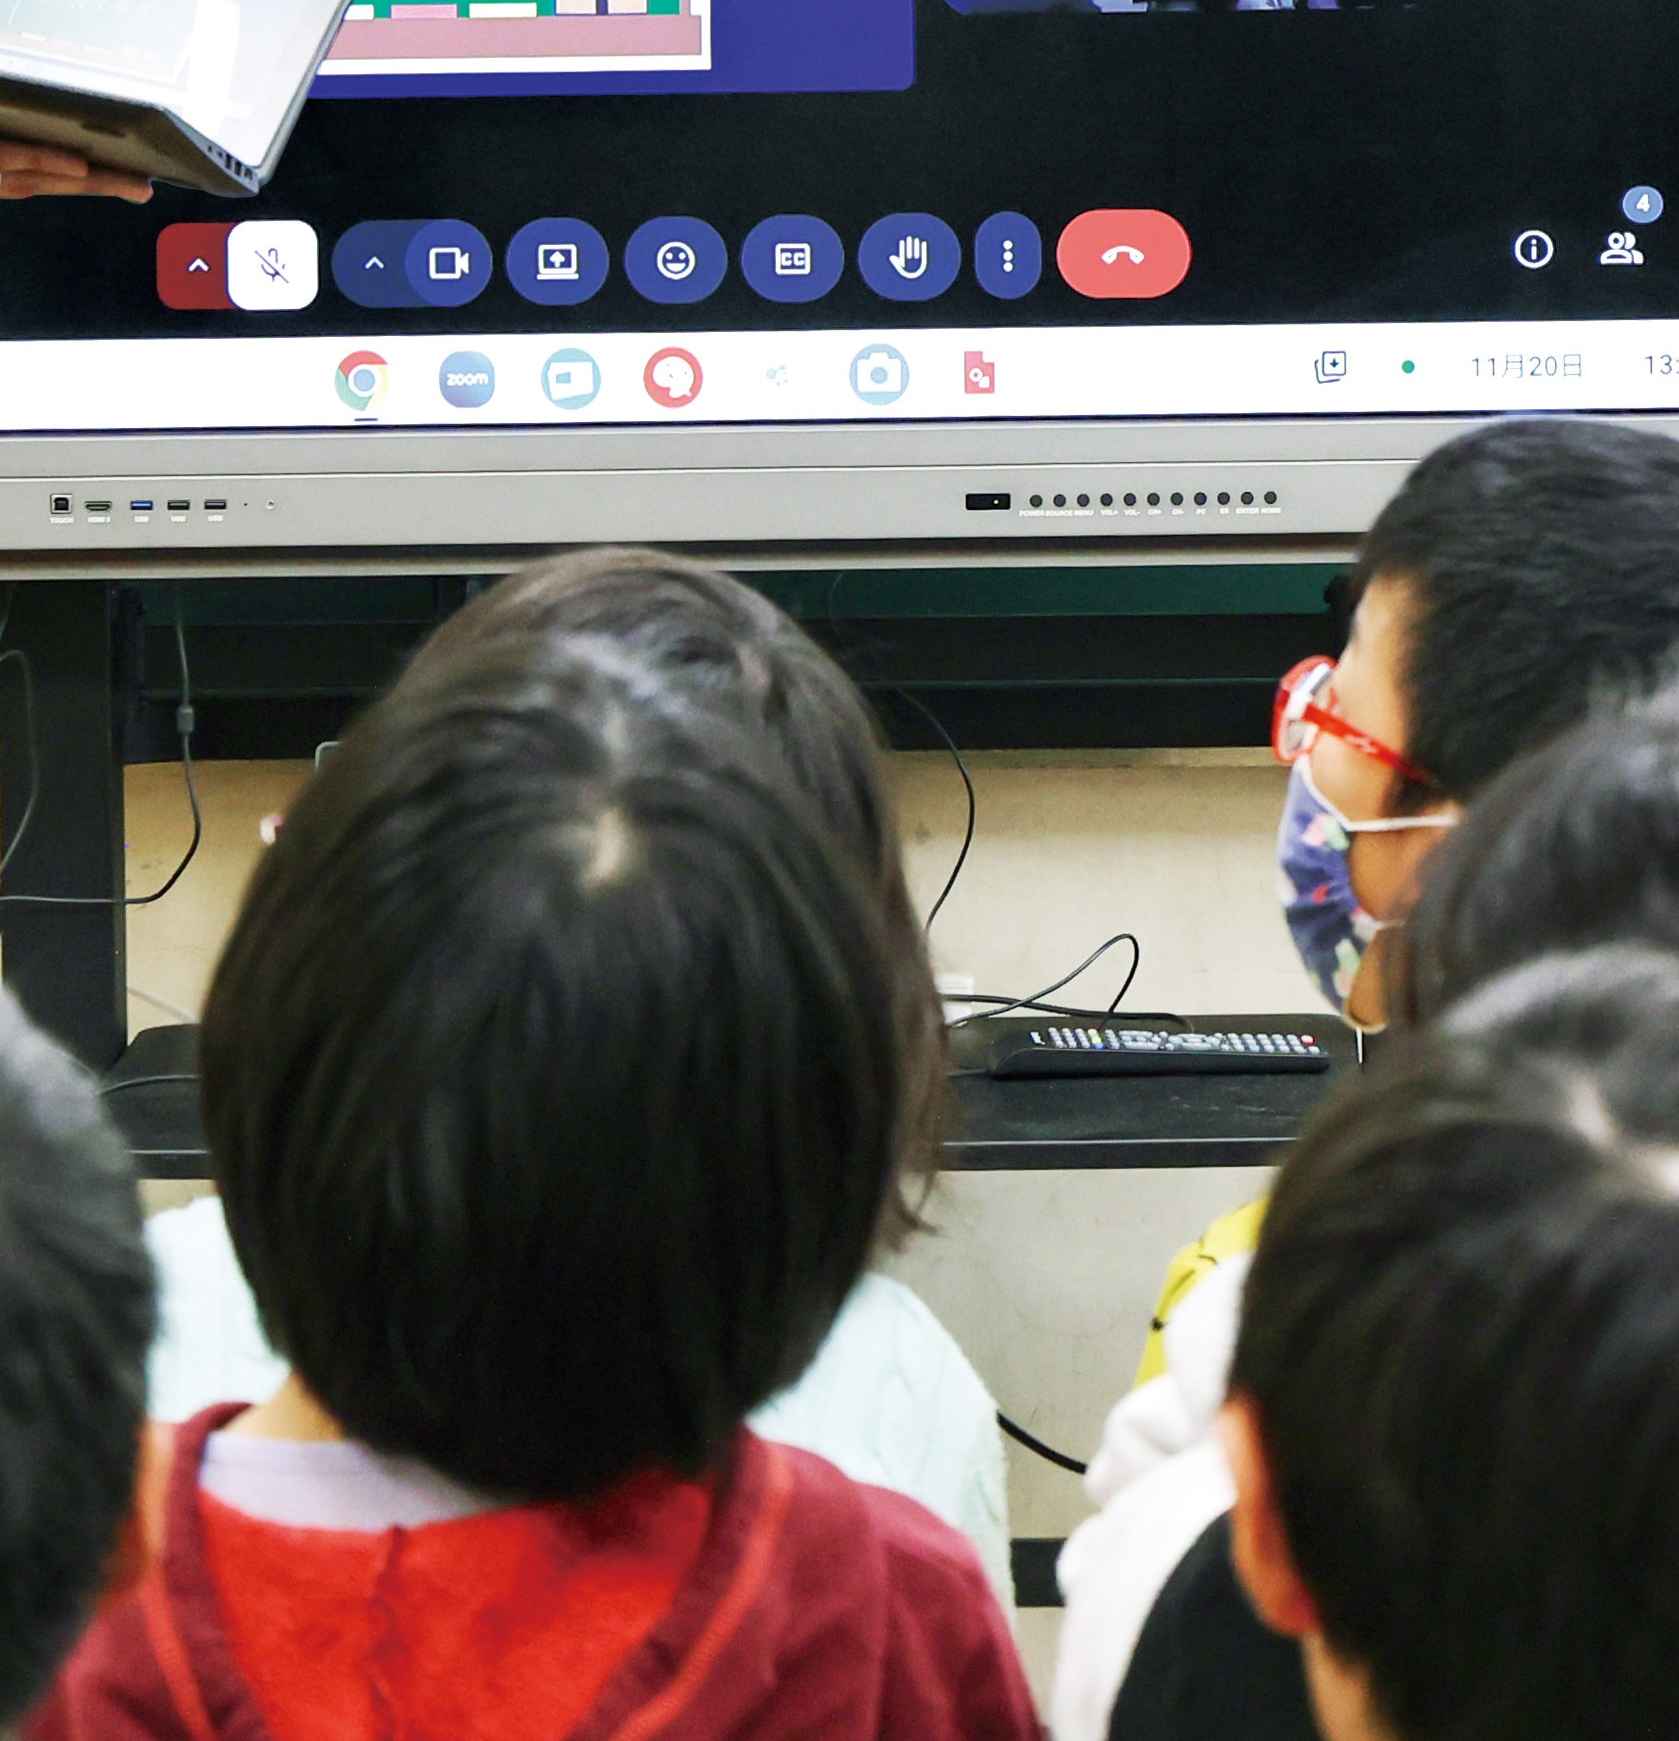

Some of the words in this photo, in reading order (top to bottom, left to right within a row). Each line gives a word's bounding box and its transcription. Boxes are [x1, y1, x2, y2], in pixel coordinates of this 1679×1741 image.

[1635, 193, 1652, 213] 4
[1471, 353, 1583, 379] 11月20日
[445, 371, 490, 387] zoom
